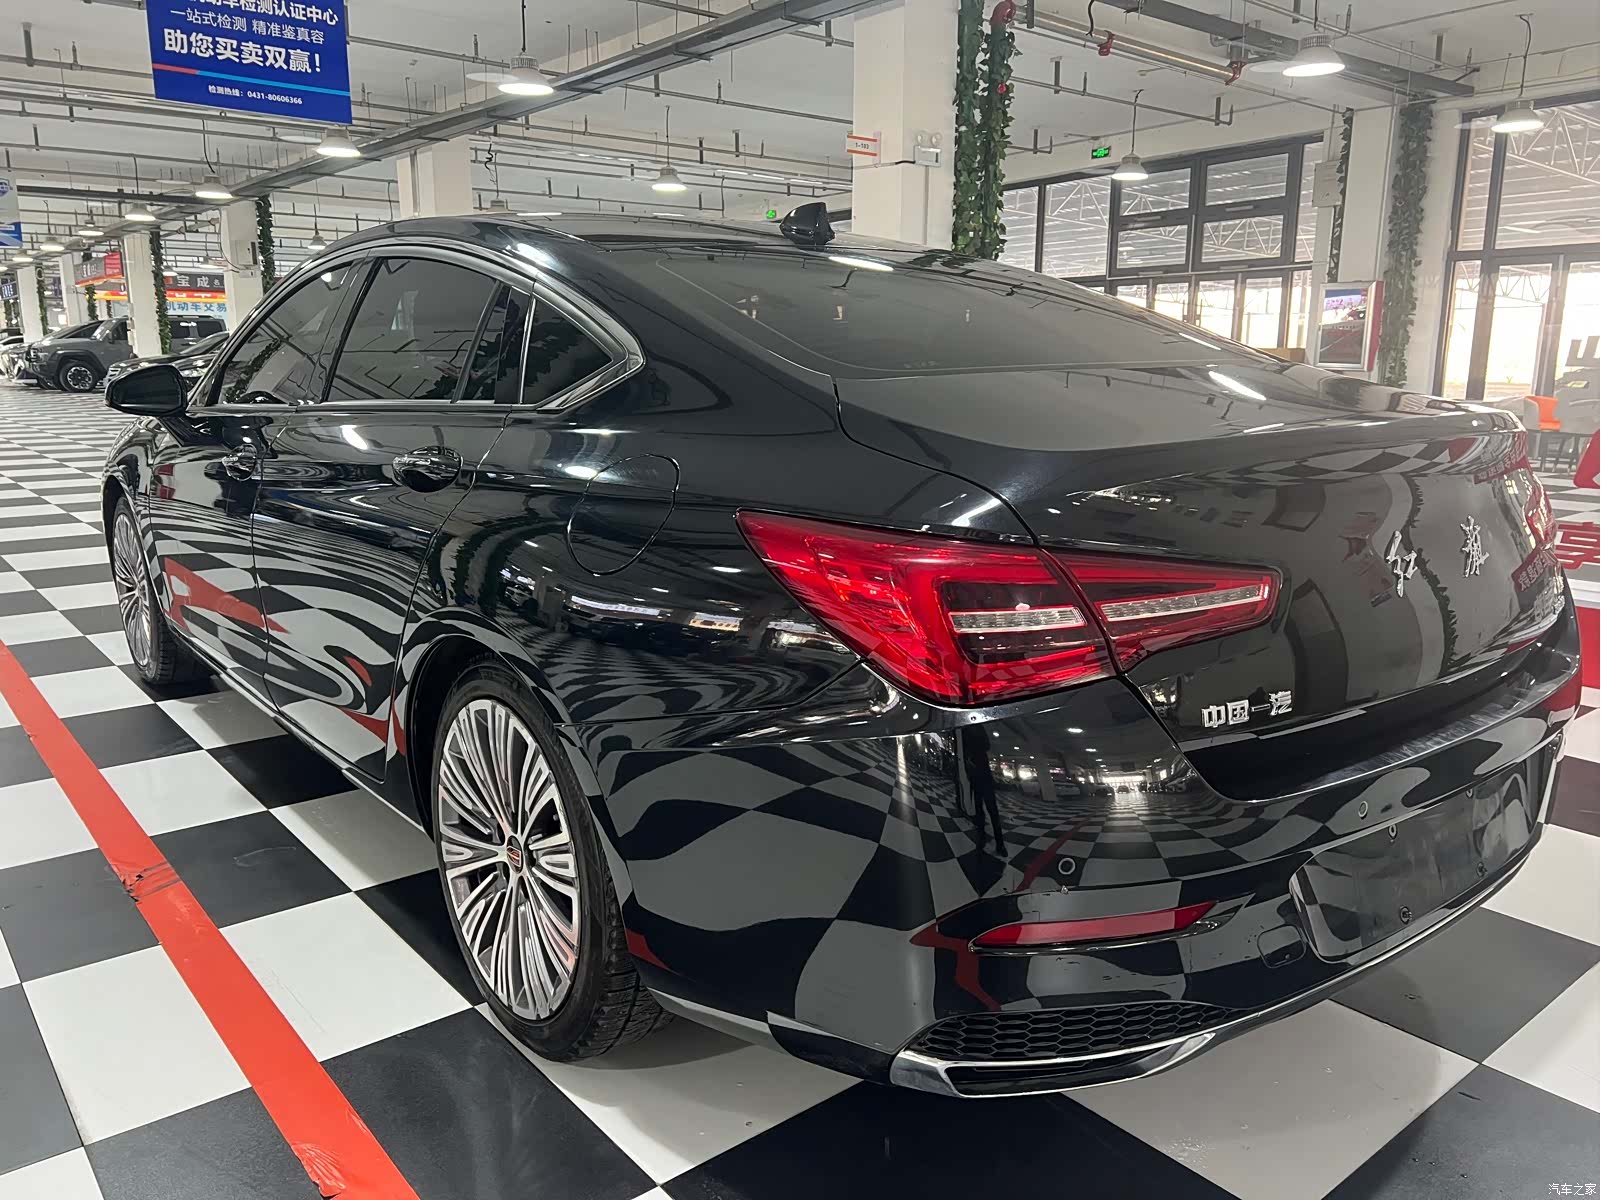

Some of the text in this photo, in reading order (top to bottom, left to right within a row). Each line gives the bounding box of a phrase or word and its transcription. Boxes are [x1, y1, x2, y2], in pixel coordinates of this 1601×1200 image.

[170, 7, 325, 45] 一站式检测 精准鉴真容
[189, 0, 339, 26] 车检测认证中心
[164, 29, 321, 74] 助您买卖双赢！
[166, 301, 227, 313] 机动车交易
[1201, 690, 1293, 728] 中国一汽
